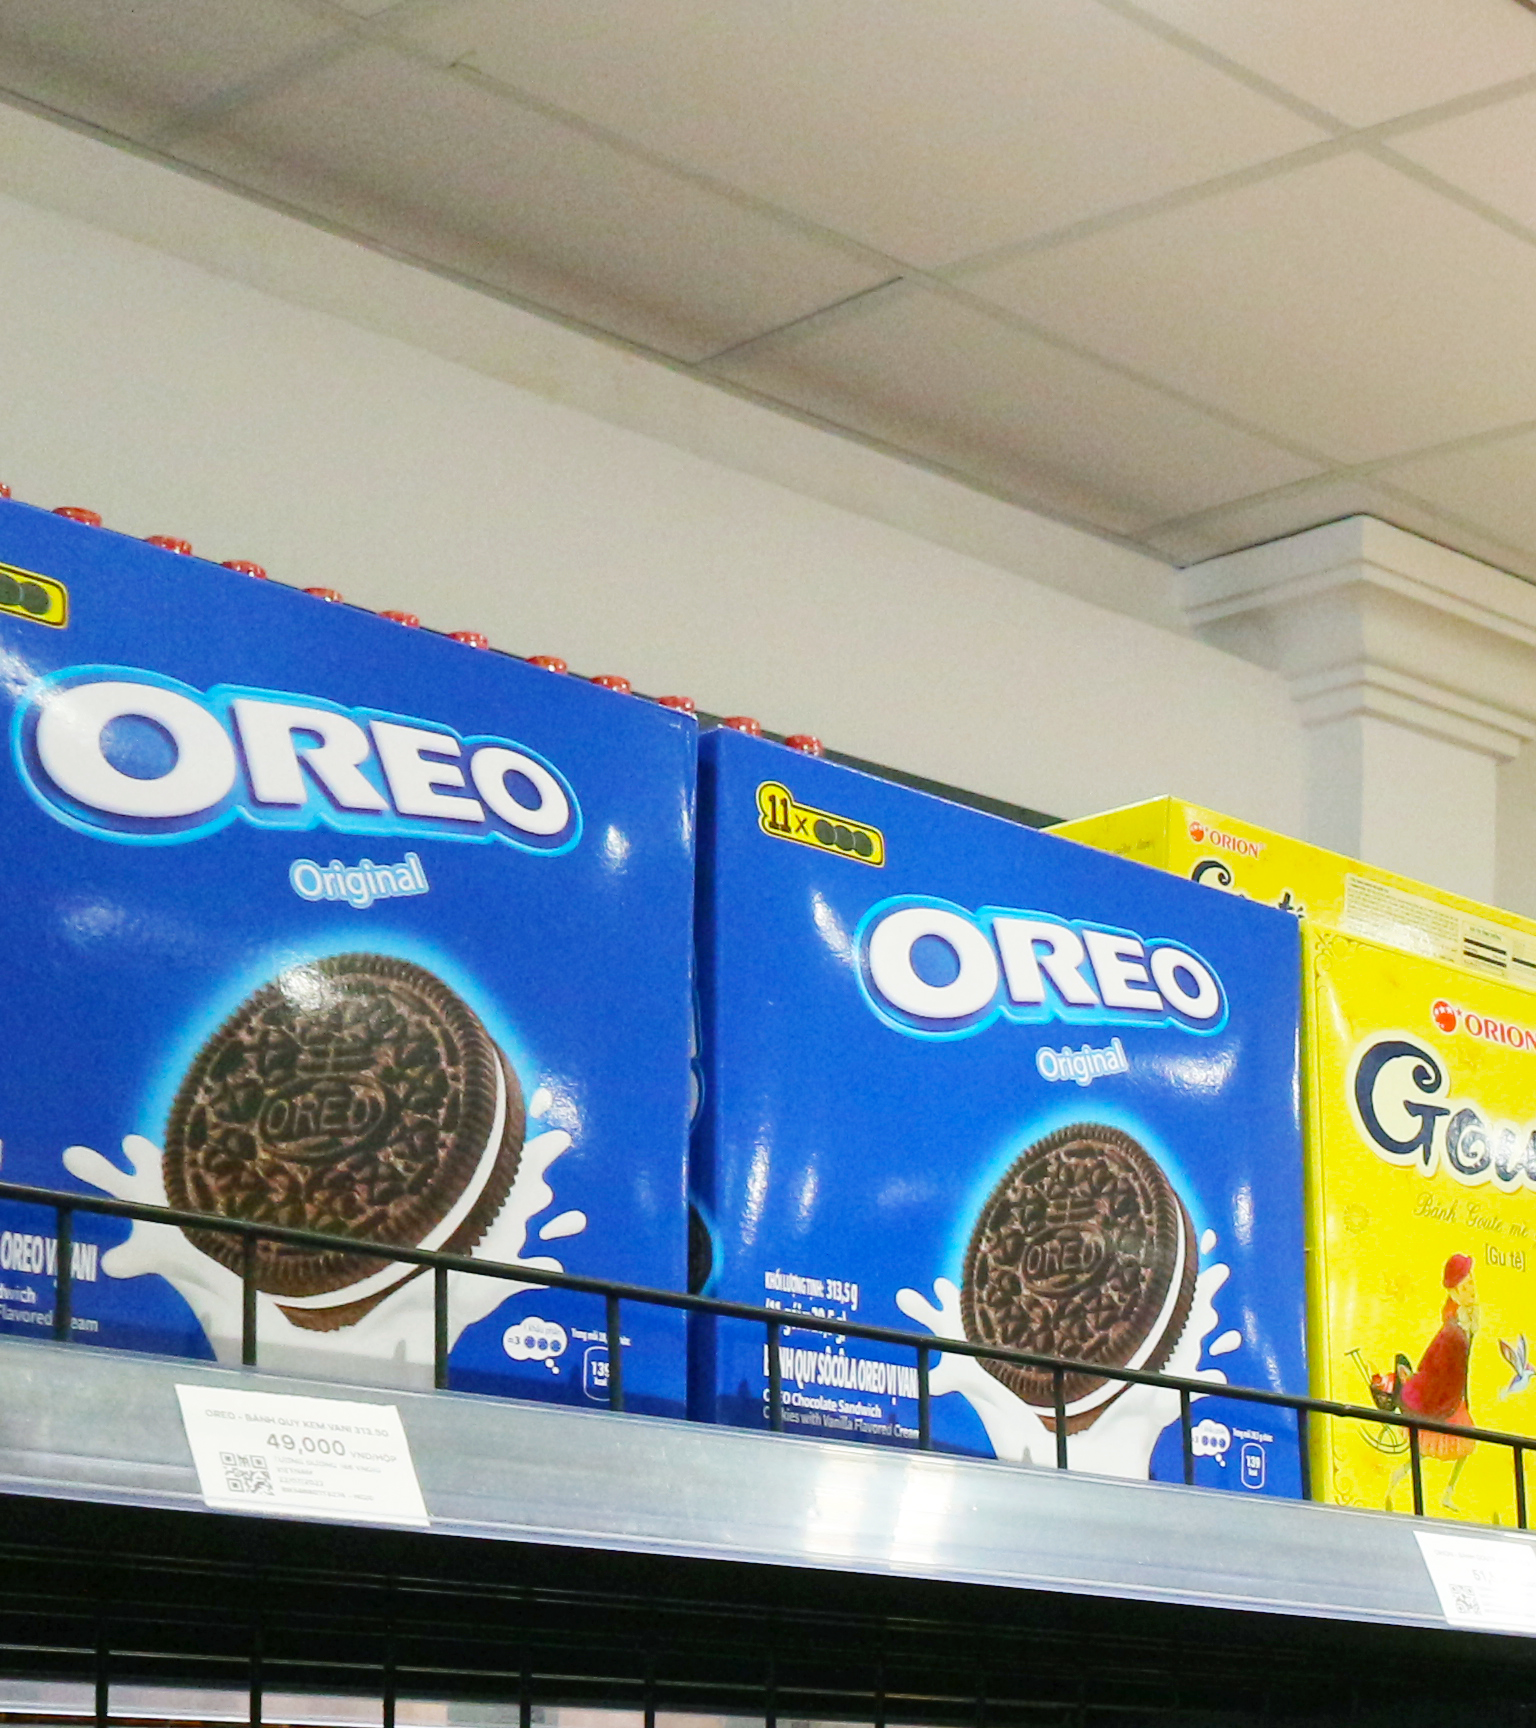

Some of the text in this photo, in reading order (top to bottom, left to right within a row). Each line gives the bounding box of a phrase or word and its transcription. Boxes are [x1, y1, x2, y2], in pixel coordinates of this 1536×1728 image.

[36, 680, 570, 836] OREO
[1207, 829, 1261, 859] ORION
[292, 854, 427, 907] Original
[869, 906, 1220, 1020] OREO
[1036, 1037, 1128, 1086] Original
[266, 1433, 346, 1456] 49,000
